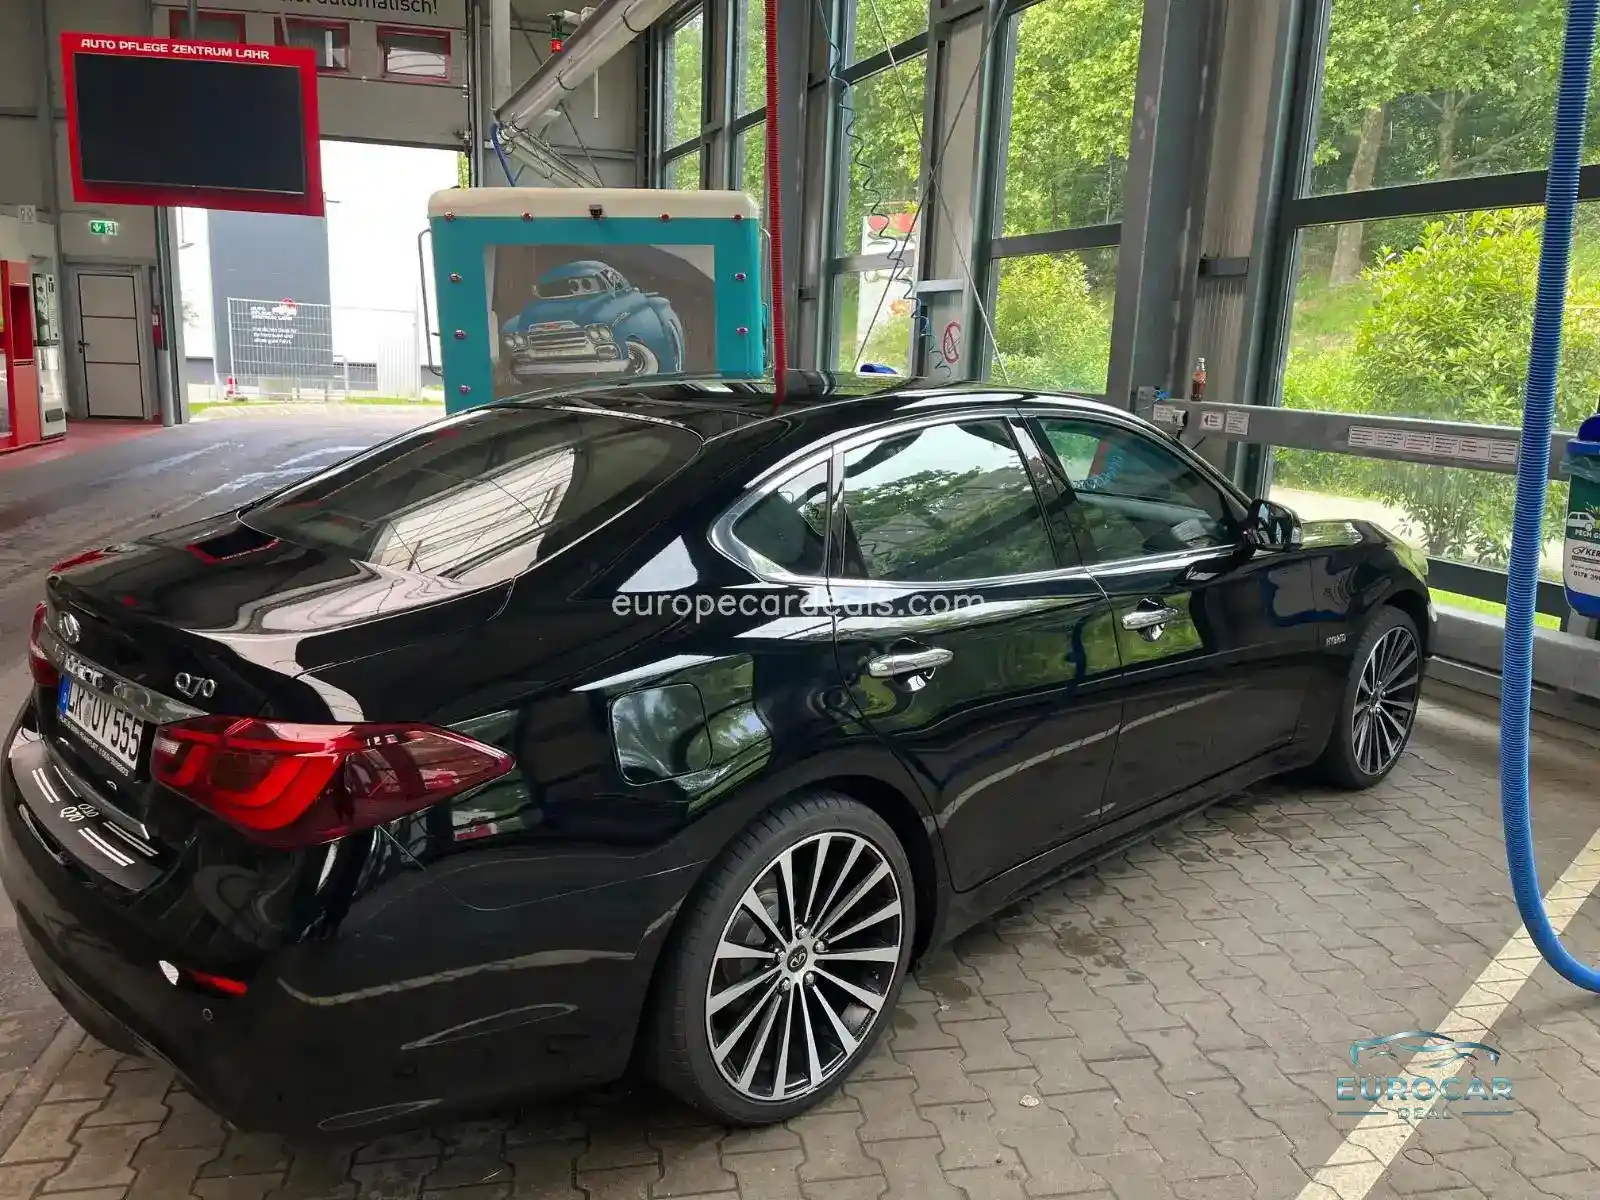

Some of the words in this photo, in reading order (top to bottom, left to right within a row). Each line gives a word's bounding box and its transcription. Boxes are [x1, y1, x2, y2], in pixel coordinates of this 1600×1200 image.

[81, 38, 116, 49] AUTO
[119, 42, 168, 53] PFLEGE
[172, 44, 232, 57] ZENTRUM
[236, 48, 270, 60] LAHR
[175, 671, 216, 699] Q70
[111, 707, 143, 762] 555
[60, 806, 85, 822] Q70
